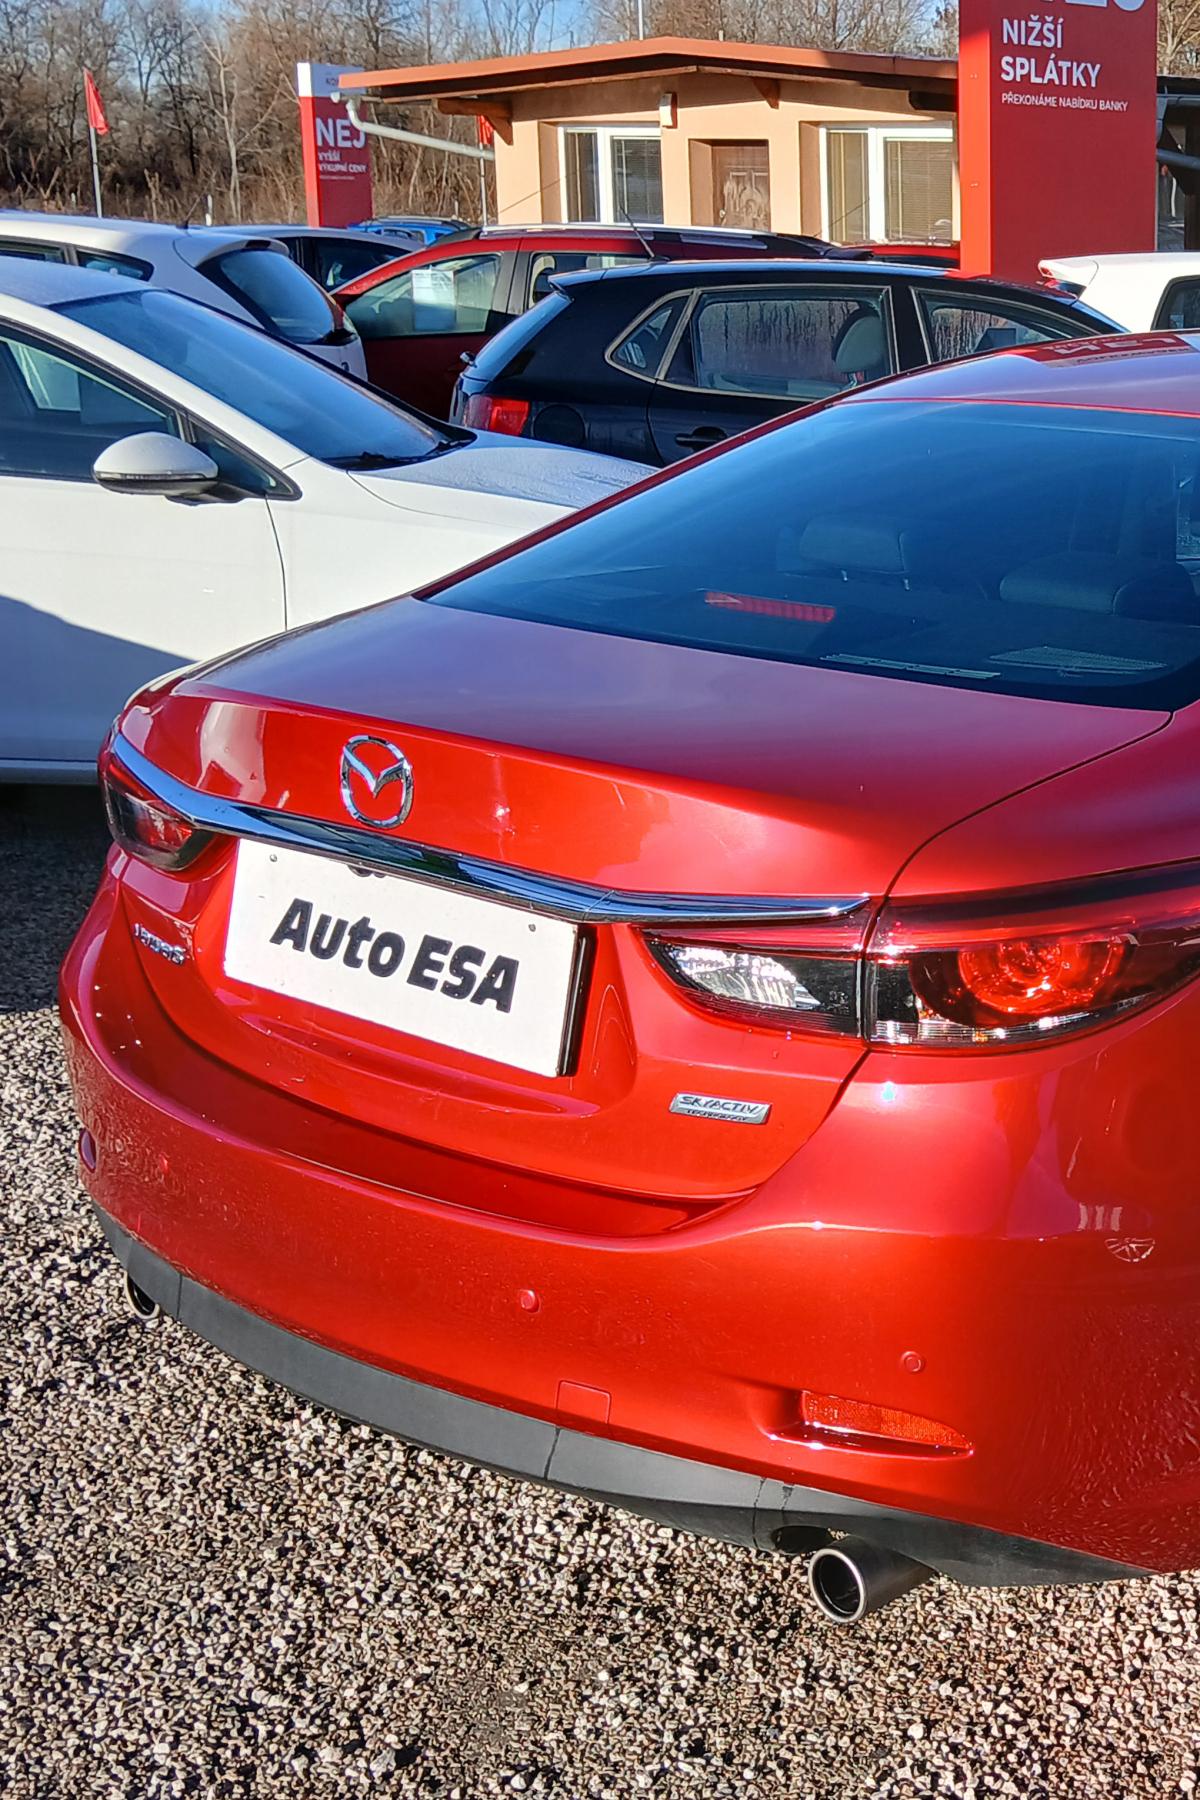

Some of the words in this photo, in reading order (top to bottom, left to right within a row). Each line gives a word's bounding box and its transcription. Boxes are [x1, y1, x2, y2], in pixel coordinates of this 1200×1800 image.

[1002, 15, 1064, 48] NIŽŠÍ
[1001, 54, 1101, 87] SPLÁTKY
[1002, 91, 1058, 107] PŘEKONÁME
[1059, 96, 1098, 109] NABÍDKU
[1099, 100, 1128, 111] BANKY
[316, 117, 366, 148] NEJ
[270, 898, 406, 977] Auto
[406, 934, 520, 1013] ESA
[680, 1096, 759, 1113] SKYACTIV
